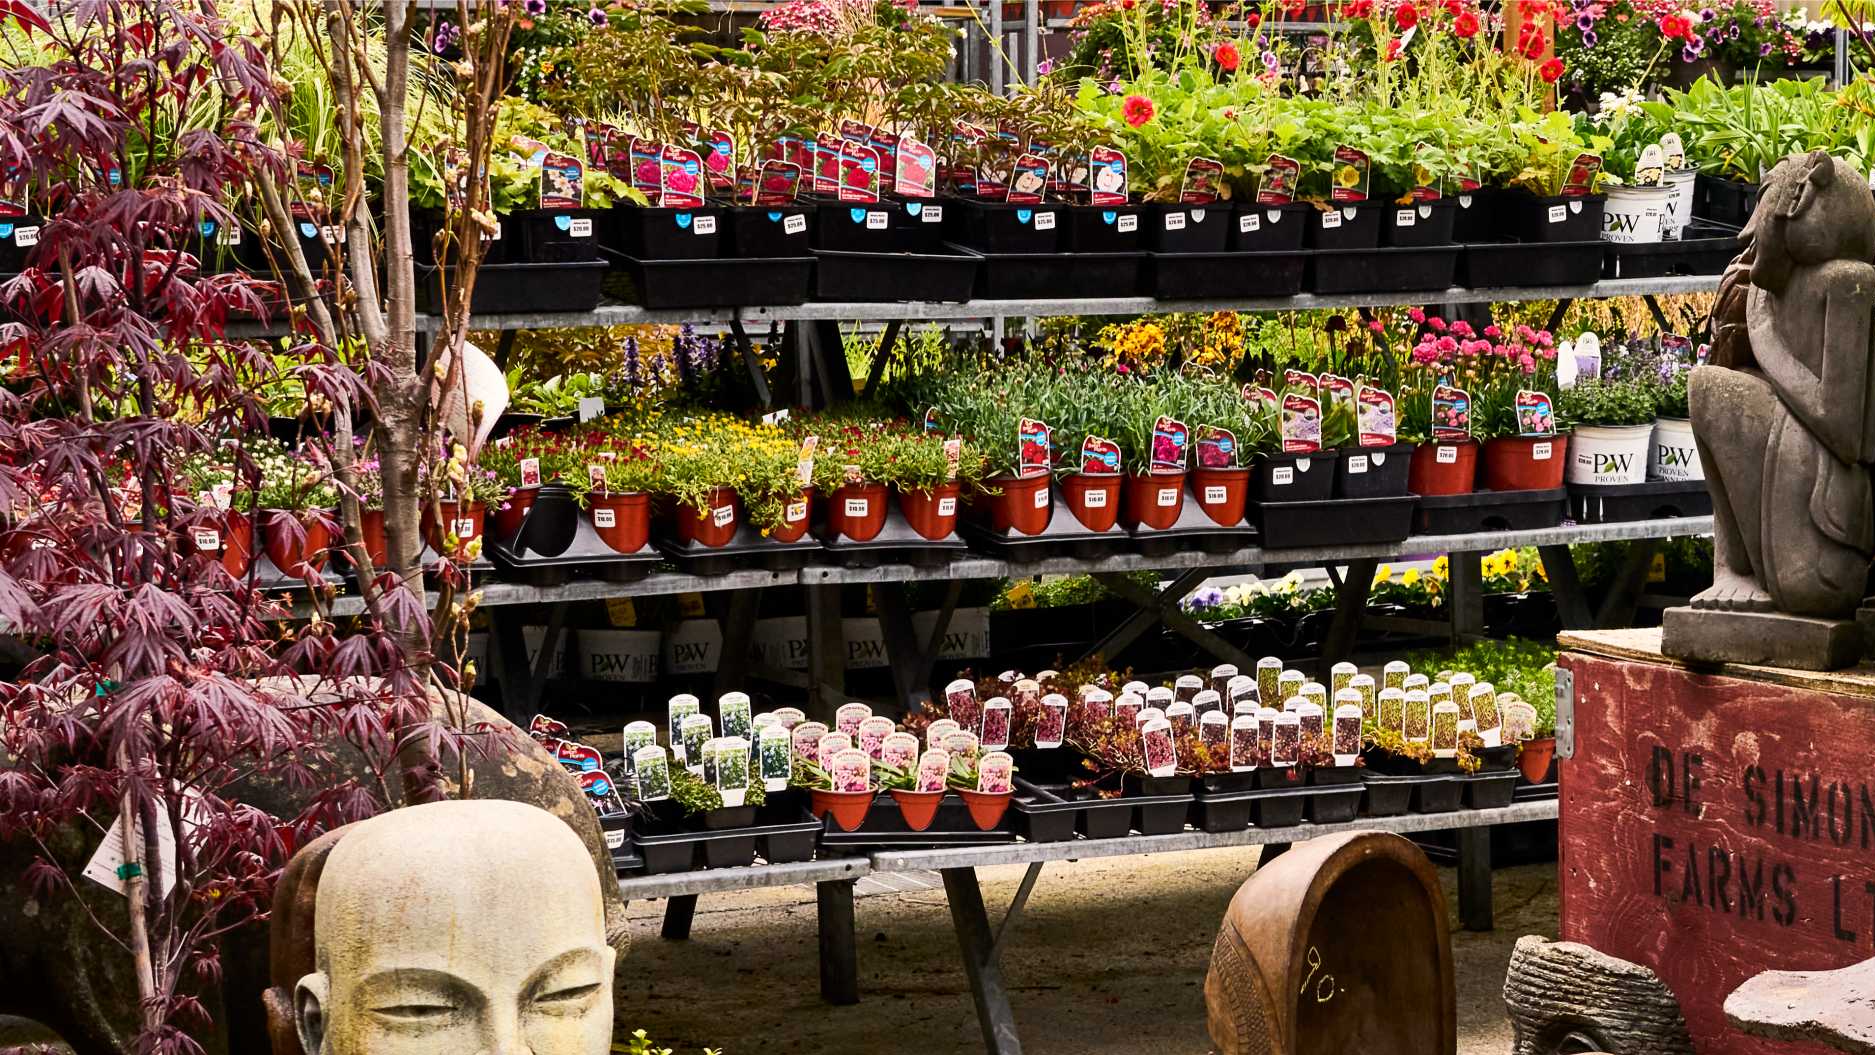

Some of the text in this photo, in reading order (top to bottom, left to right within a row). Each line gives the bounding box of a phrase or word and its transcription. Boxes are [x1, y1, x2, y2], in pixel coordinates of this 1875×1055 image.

[1601, 212, 1640, 233] PW
[1593, 453, 1634, 473] PW
[1657, 444, 1695, 467] PW
[1595, 475, 1628, 483] PROVEN
[1658, 466, 1689, 477] PROVEN
[1650, 744, 1702, 820] DE
[1652, 832, 1797, 927] FARMS
